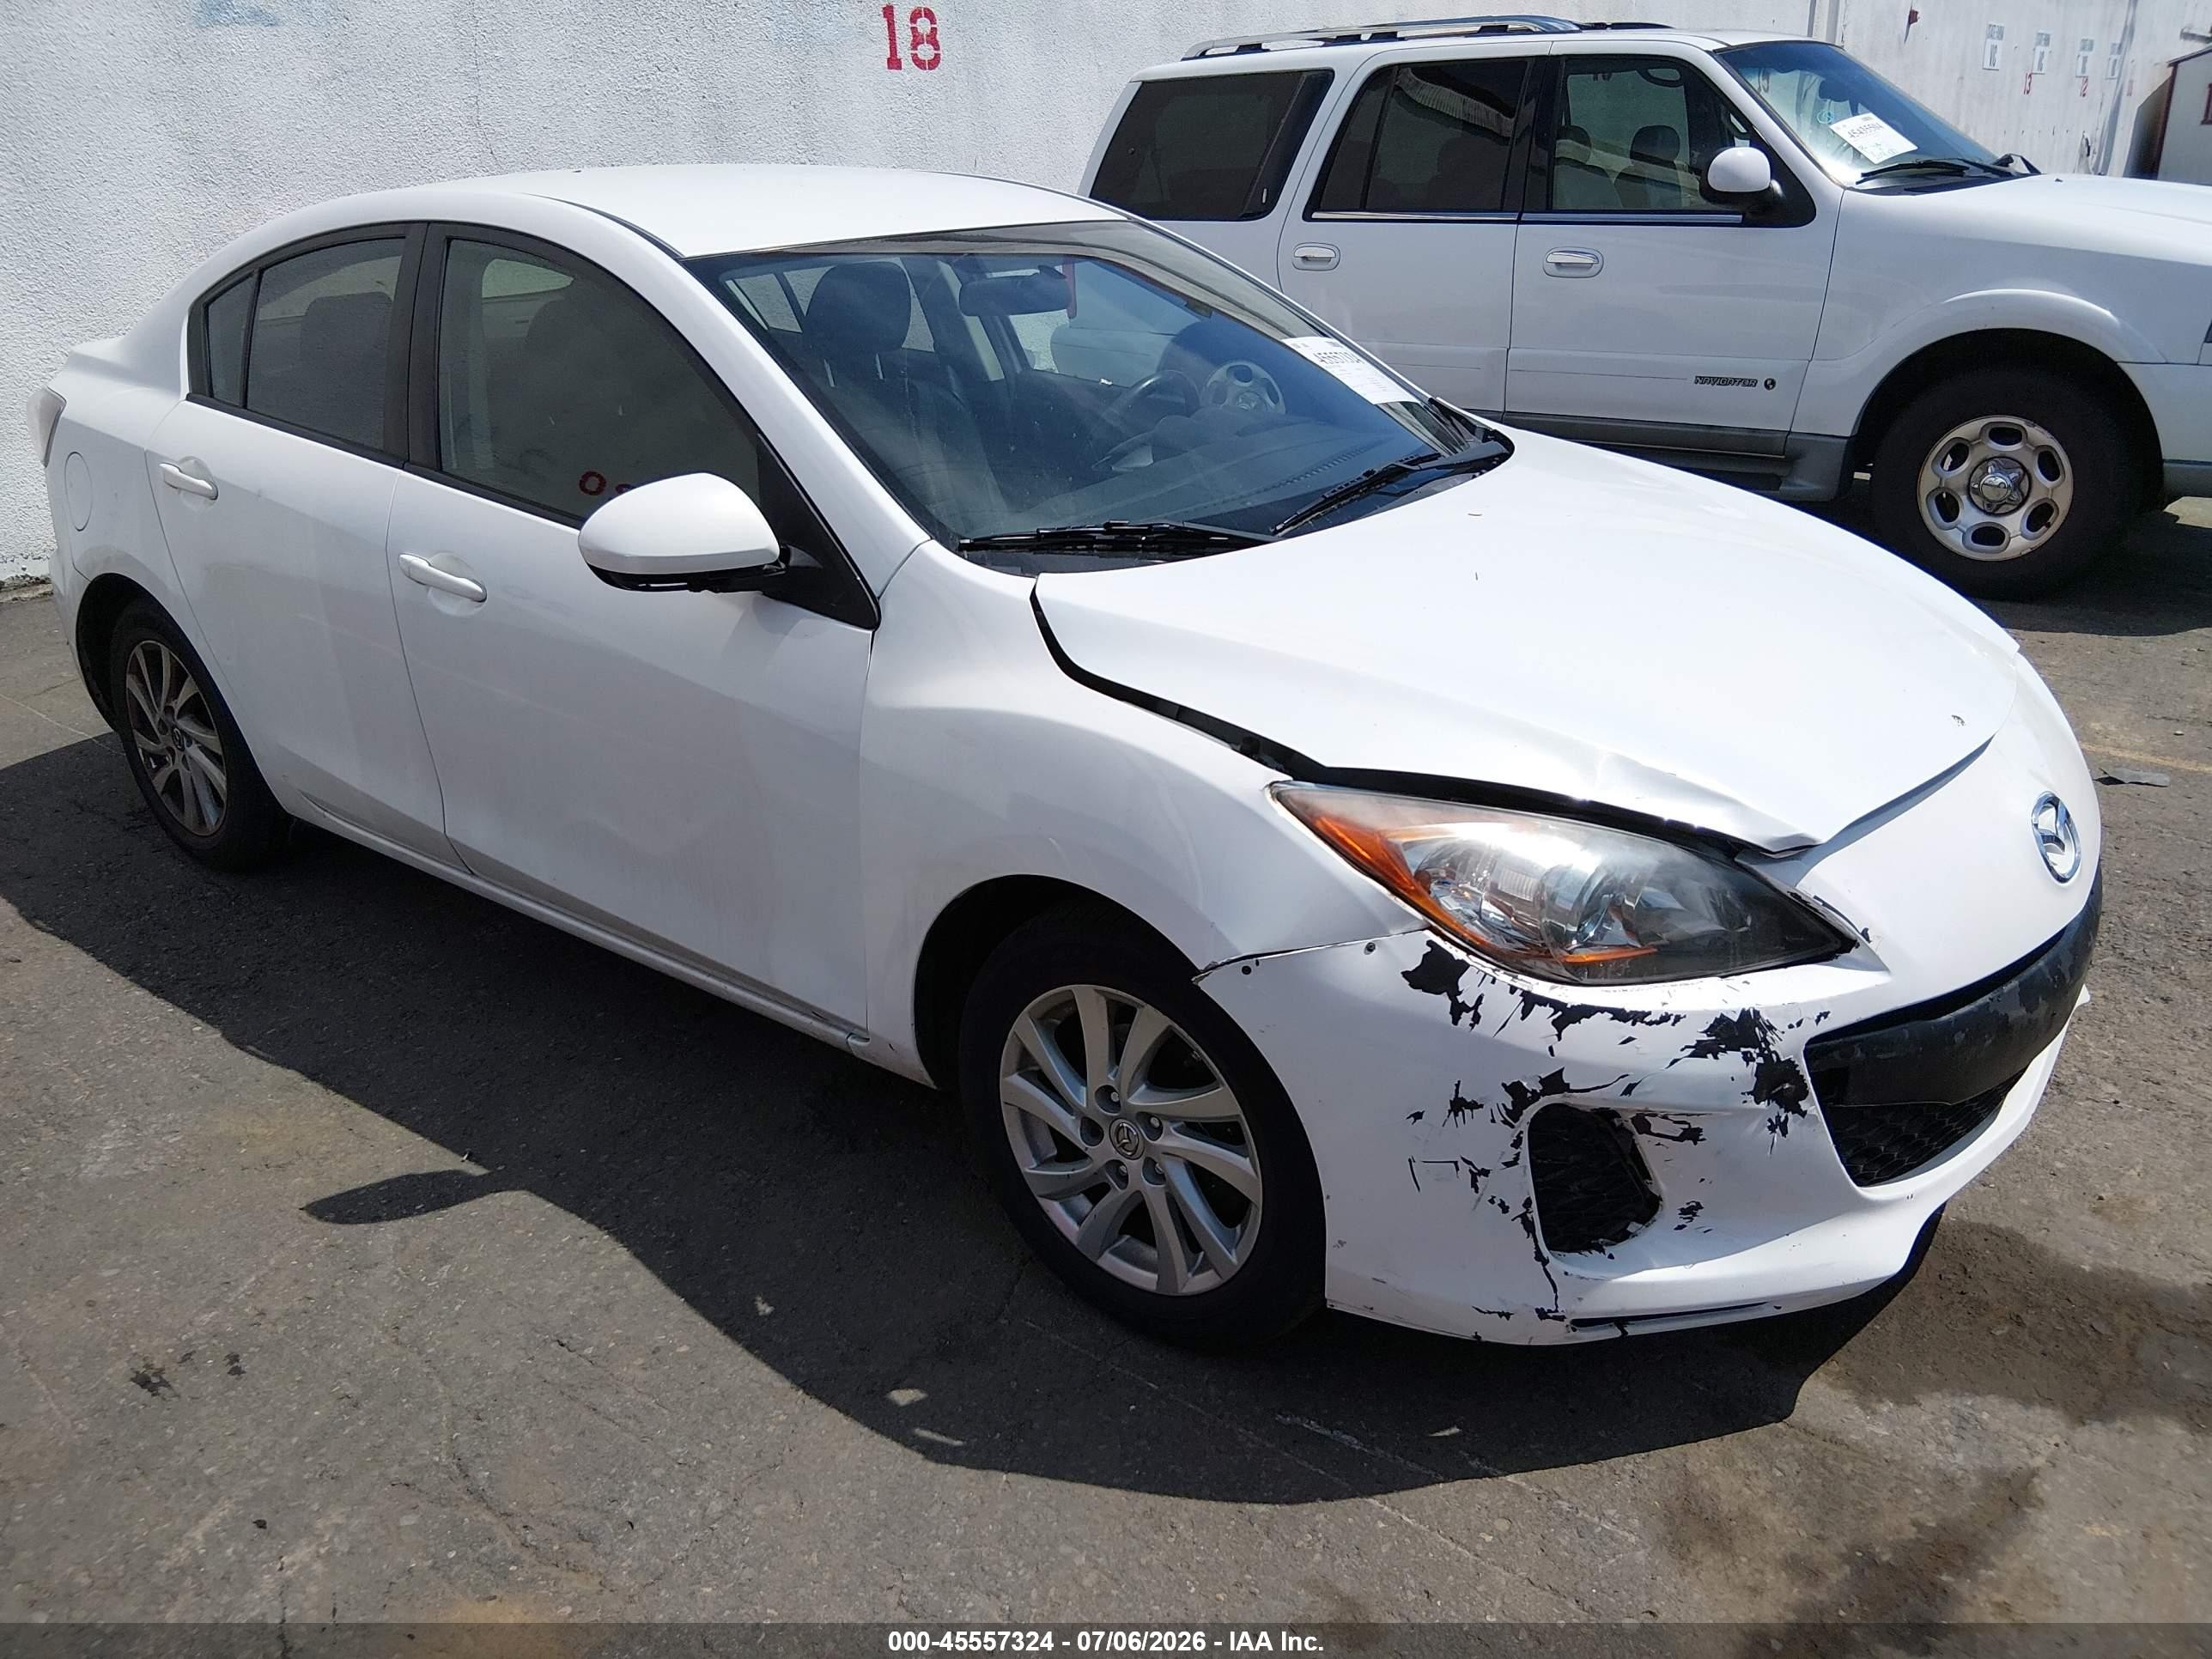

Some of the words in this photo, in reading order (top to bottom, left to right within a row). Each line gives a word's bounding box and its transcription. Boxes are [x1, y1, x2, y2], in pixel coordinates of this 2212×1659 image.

[882, 4, 941, 70] 18
[2023, 71, 2033, 95] 13
[1694, 375, 1758, 387] NAVIGATOR
